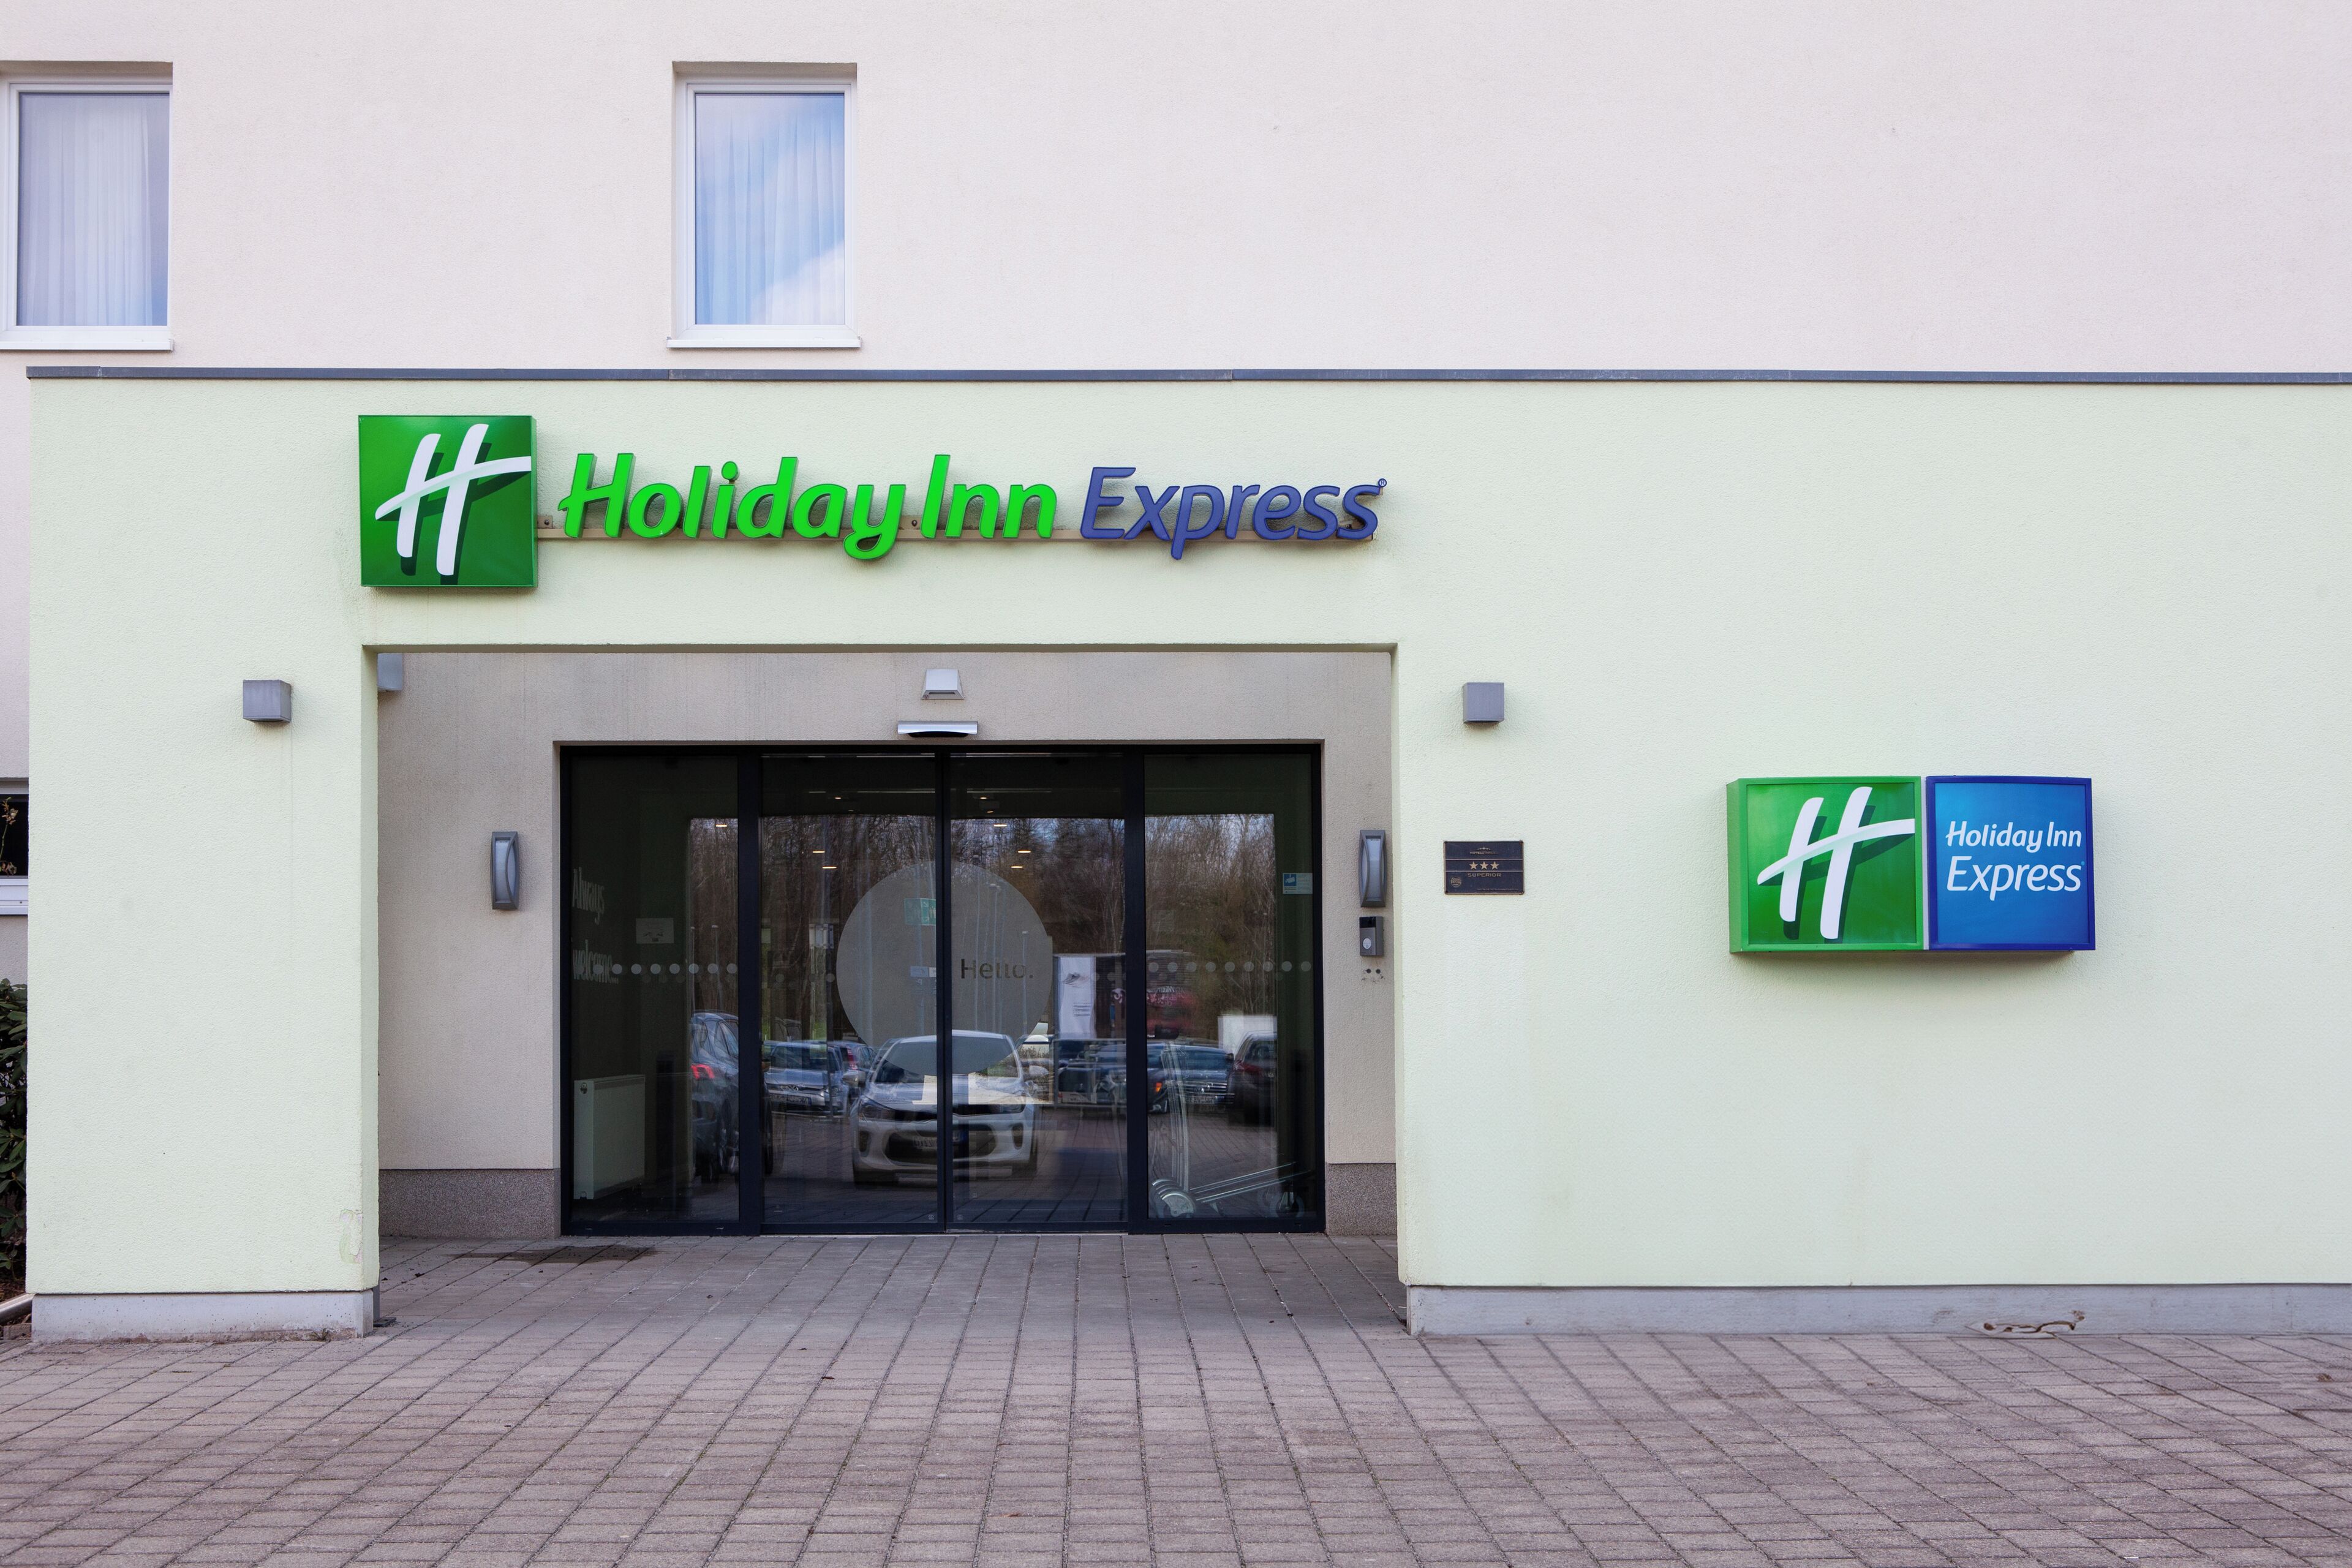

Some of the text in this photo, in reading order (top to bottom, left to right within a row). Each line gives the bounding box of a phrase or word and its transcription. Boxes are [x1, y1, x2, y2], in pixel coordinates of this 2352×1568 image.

[557, 453, 906, 560] Holiday
[919, 454, 1058, 539] Inn
[1945, 820, 2082, 853] Holiday Inn
